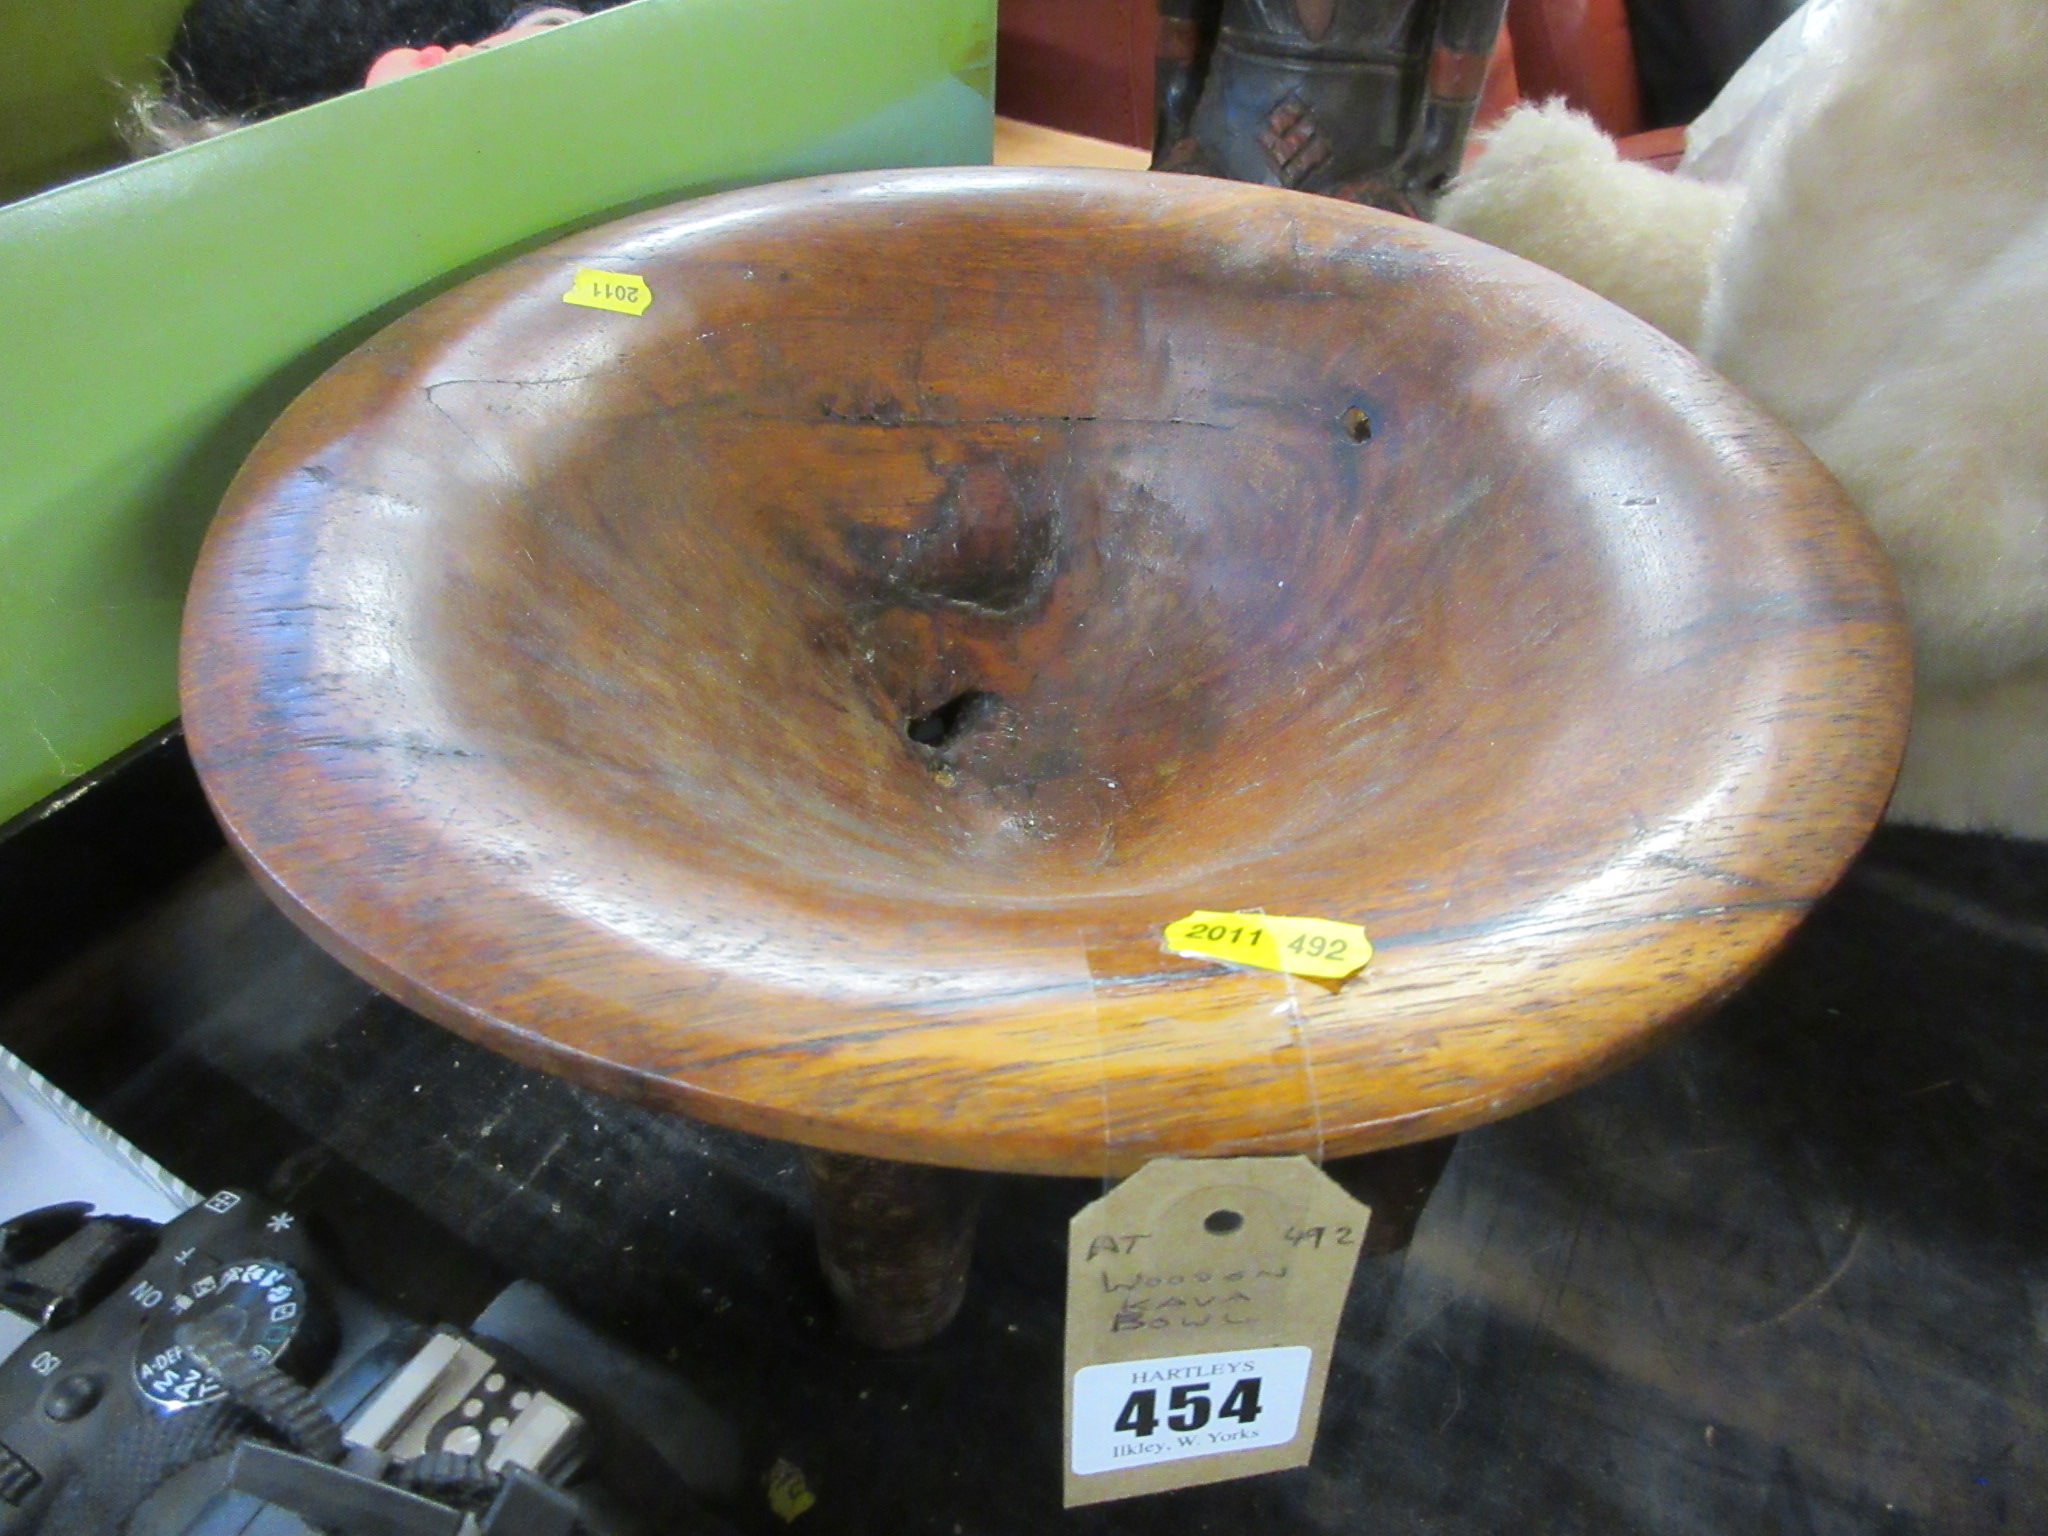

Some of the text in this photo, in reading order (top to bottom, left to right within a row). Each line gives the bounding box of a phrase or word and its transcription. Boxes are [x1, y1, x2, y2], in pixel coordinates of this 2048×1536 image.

[593, 282, 639, 303] 2011
[1184, 923, 1349, 963] 2011 492
[1085, 1232, 1152, 1262] AT
[1283, 1225, 1355, 1249] 492
[1110, 1311, 1260, 1333] BOWL
[1132, 1359, 1256, 1385] HARTLEYS
[1114, 1376, 1263, 1437] 454
[1112, 1440, 1171, 1459] Ilkley,
[1207, 1428, 1260, 1444] Yorks
